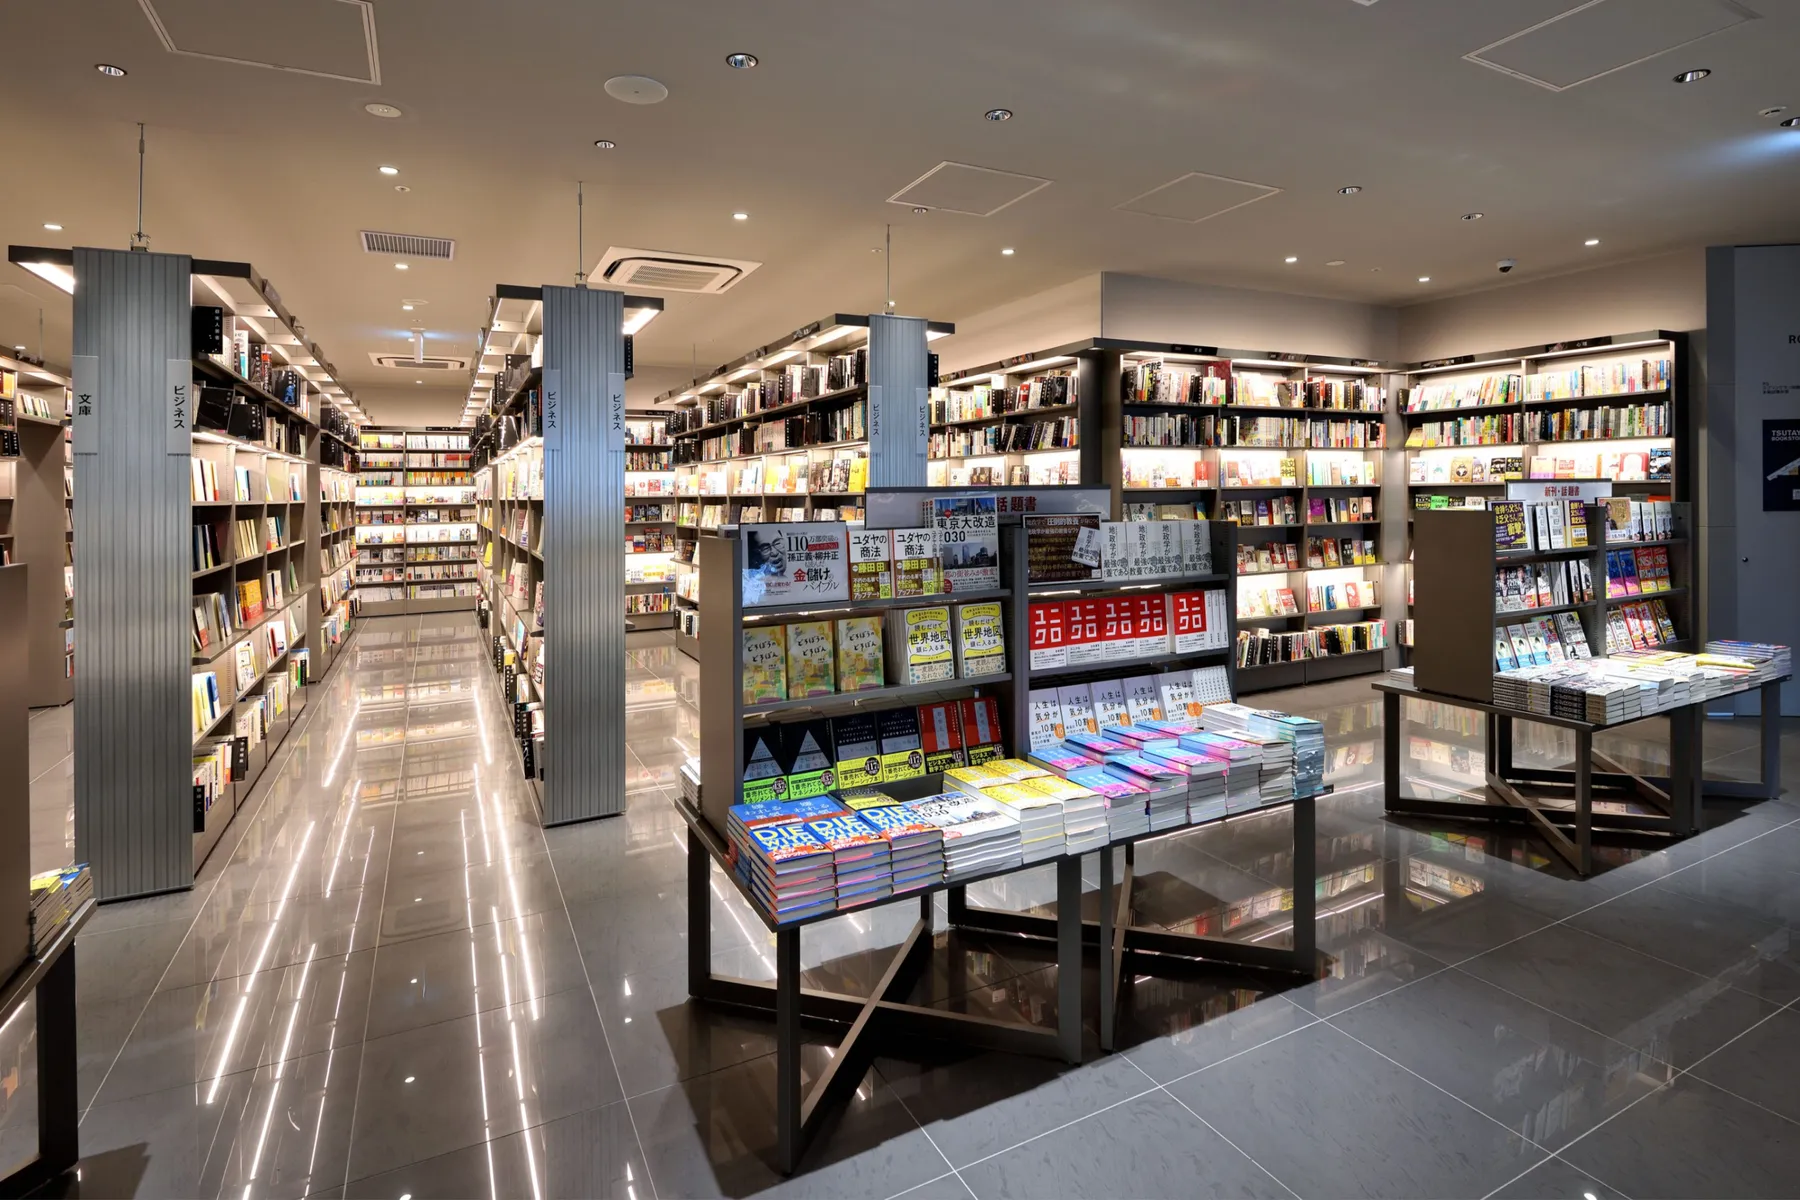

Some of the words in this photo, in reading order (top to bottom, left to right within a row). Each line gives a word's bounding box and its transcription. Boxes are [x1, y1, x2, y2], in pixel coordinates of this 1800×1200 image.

[78, 394, 92, 416] 文庫
[174, 385, 186, 429] ビジネス
[547, 391, 557, 429] ビジネス
[613, 394, 621, 430] ビジネス
[1544, 486, 1580, 497] 新刊・話題書
[936, 516, 996, 530] 東京大改造
[852, 534, 888, 546] ユダヤの
[896, 532, 931, 544] ユダヤの
[943, 531, 966, 543] 030
[1108, 526, 1116, 559] 地政学が
[1138, 525, 1147, 557] 地政学が
[1162, 524, 1170, 556] 地政学が
[860, 546, 881, 558] 商法
[904, 544, 925, 556] 商法
[1104, 568, 1129, 577] 養である
[802, 581, 840, 593] バイブル
[1105, 602, 1131, 618] ユニ
[1139, 599, 1162, 615] ユニ
[1178, 597, 1201, 612] ユニ
[1034, 608, 1061, 625] ユニ
[1070, 604, 1096, 621] ユニ
[914, 622, 943, 631] 読むだけで
[968, 618, 995, 626] 読むだけで
[1105, 620, 1132, 636] クロ
[1139, 617, 1163, 633] クロ
[1179, 614, 1202, 630] クロ
[1034, 627, 1062, 645] クロ
[1070, 623, 1097, 640] クロ
[916, 644, 945, 653] 頭に入る本
[970, 639, 997, 647] 頭に入る本
[1133, 686, 1153, 696] 人生は
[1168, 681, 1188, 691] 人生は
[1068, 695, 1088, 705] 人生は
[1101, 691, 1121, 701] 人生は
[1135, 696, 1155, 706] 気分が
[1170, 691, 1189, 701] 気分が
[1034, 700, 1057, 710] 人生は
[1069, 706, 1090, 716] 気分が
[1102, 702, 1123, 711] 気分が
[1035, 711, 1058, 721] 気分が
[744, 789, 773, 799] 番売れてる
[860, 805, 909, 821] DIE
[872, 811, 921, 827] WITH
[809, 815, 858, 831] DIE
[752, 823, 804, 840] DIE
[819, 823, 871, 838] WITH
[762, 832, 816, 848] WITH
